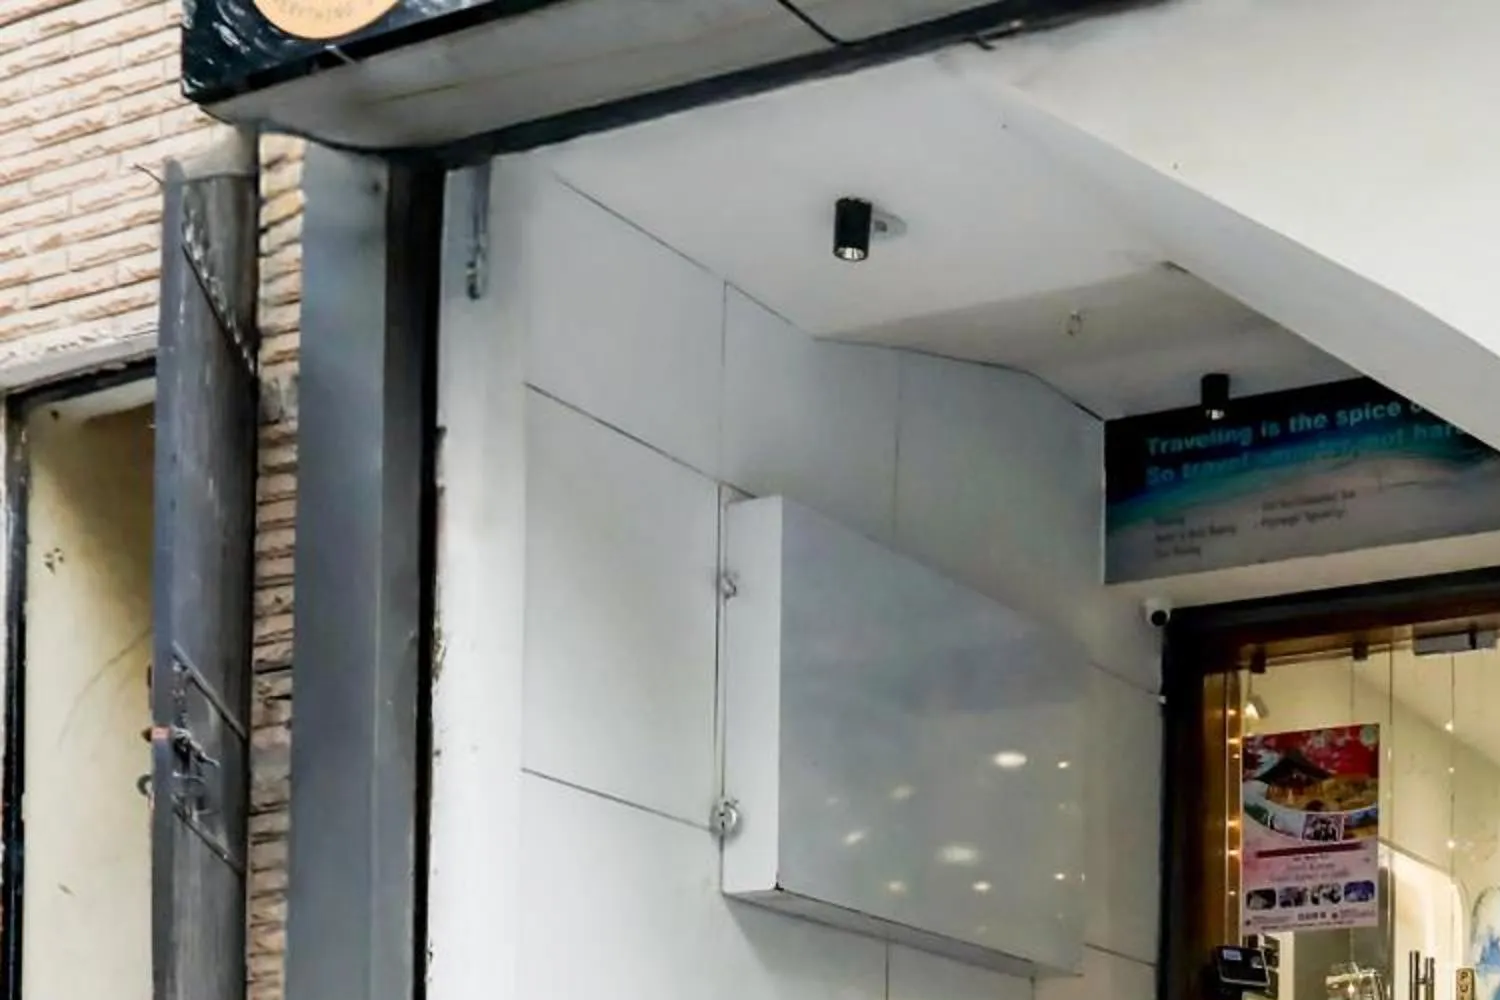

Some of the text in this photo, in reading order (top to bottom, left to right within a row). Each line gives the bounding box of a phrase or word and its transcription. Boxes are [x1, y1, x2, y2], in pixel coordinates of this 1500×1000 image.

[1147, 426, 1253, 456] Traveling
[1261, 420, 1280, 438] is
[1289, 411, 1328, 434] the
[1335, 400, 1402, 427] spice
[1146, 464, 1176, 483] So
